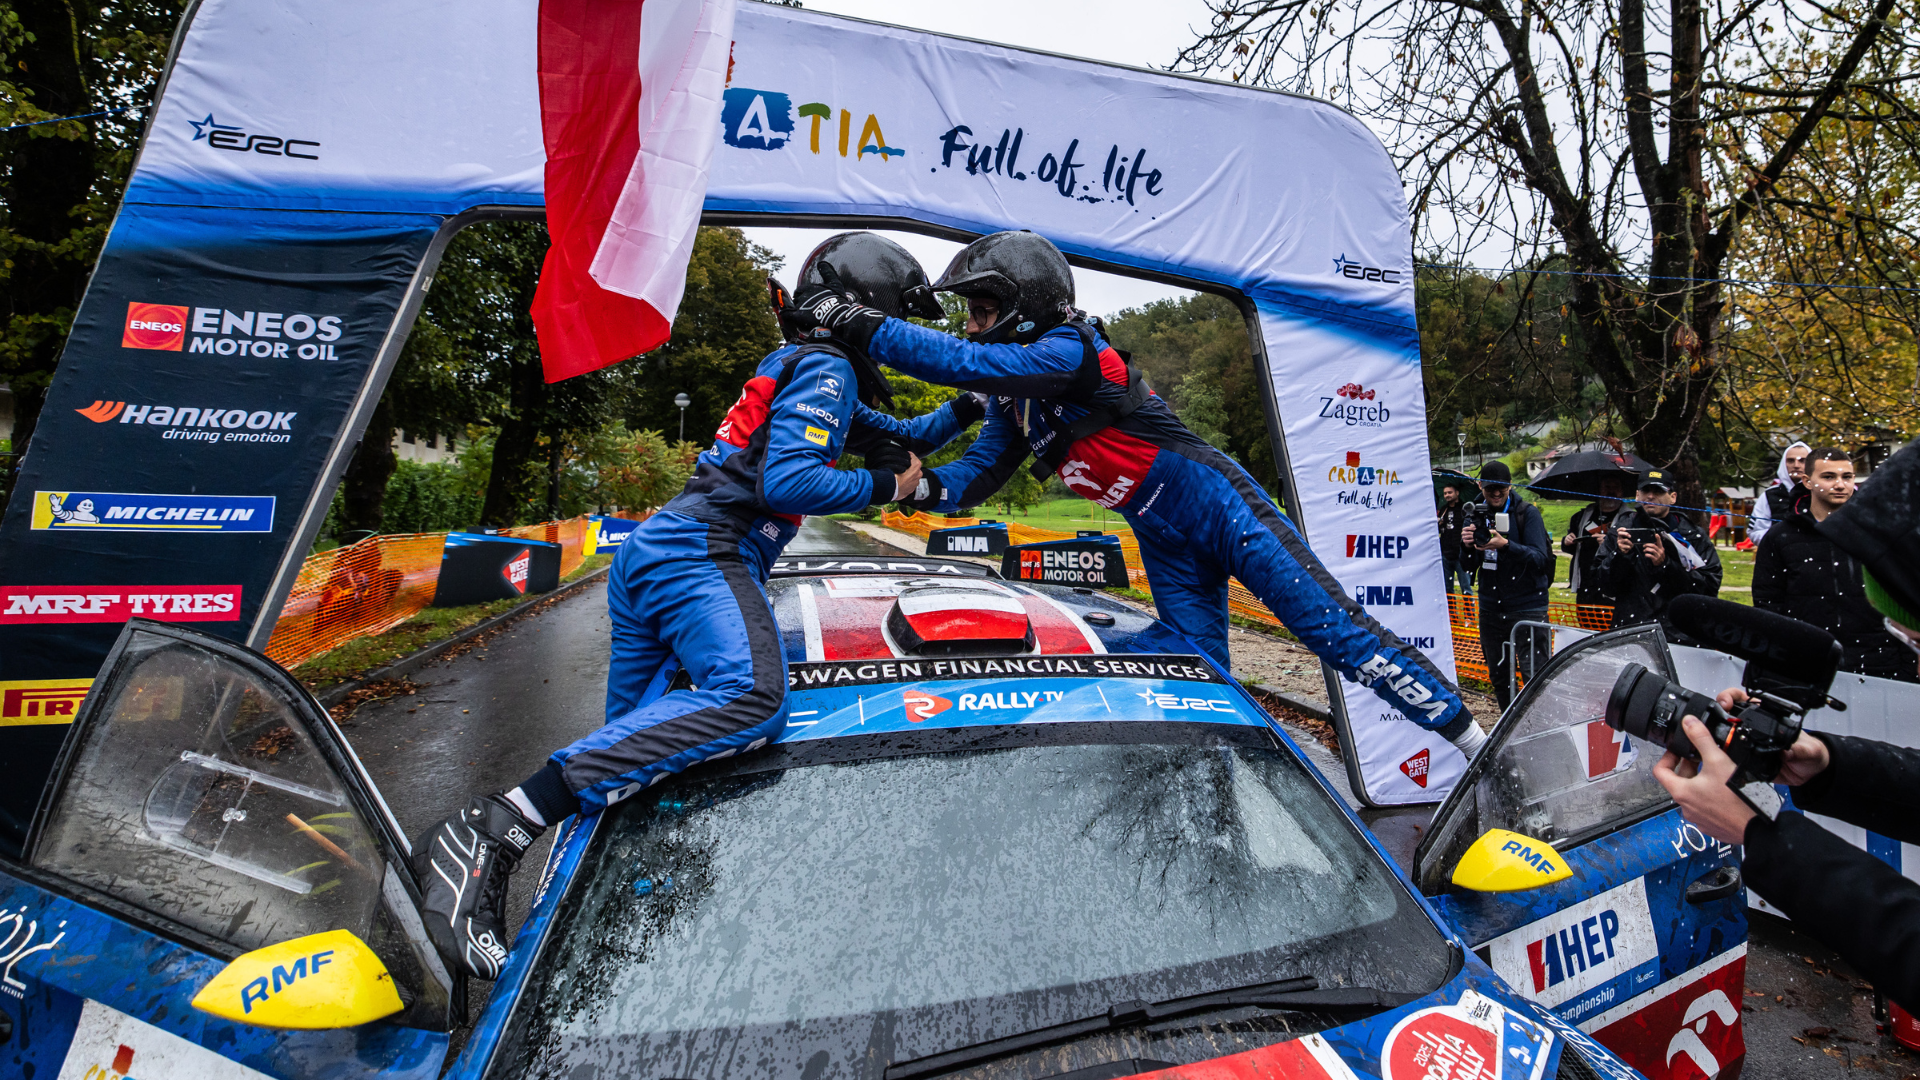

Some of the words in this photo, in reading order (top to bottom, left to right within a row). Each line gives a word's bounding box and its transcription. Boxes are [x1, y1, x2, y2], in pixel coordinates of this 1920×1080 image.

[207, 131, 321, 161] ERC
[938, 124, 1022, 180] Full
[1036, 137, 1086, 198] of
[1102, 143, 1164, 207] life
[1343, 264, 1401, 284] ERC
[129, 319, 182, 335] ENEOS
[191, 306, 343, 343] ENEOS
[189, 336, 290, 360] MOTOR
[297, 344, 340, 362] OIL
[1318, 396, 1390, 427] Zagreb
[161, 428, 220, 445] driving
[223, 431, 292, 444] emotion
[807, 430, 826, 441] RMF
[1328, 465, 1404, 486] CROATIA
[1337, 490, 1358, 505] Full
[1360, 491, 1374, 508] of
[1375, 492, 1394, 509] life
[104, 505, 255, 522] MICHELIN
[947, 535, 989, 552] INA
[1368, 535, 1410, 559] HEP
[509, 557, 530, 573] WEST
[1043, 550, 1106, 570] ENEOS
[510, 570, 528, 584] GATE
[1043, 568, 1085, 583] MOTOR
[1087, 571, 1107, 584] OIL
[3, 594, 121, 615] MRF
[128, 592, 235, 614] TYRES
[1355, 585, 1414, 606] INA
[933, 658, 1090, 676] FINANCIAL
[1093, 660, 1210, 680] SERVICES
[1155, 695, 1237, 713] ERC
[1406, 756, 1429, 770] WEST
[1409, 766, 1428, 778] GATE
[507, 824, 531, 849] OMP
[473, 842, 487, 878] ONE-S
[1500, 839, 1556, 876] RMF
[1566, 908, 1620, 979] HEP
[240, 949, 335, 1015] RMF
